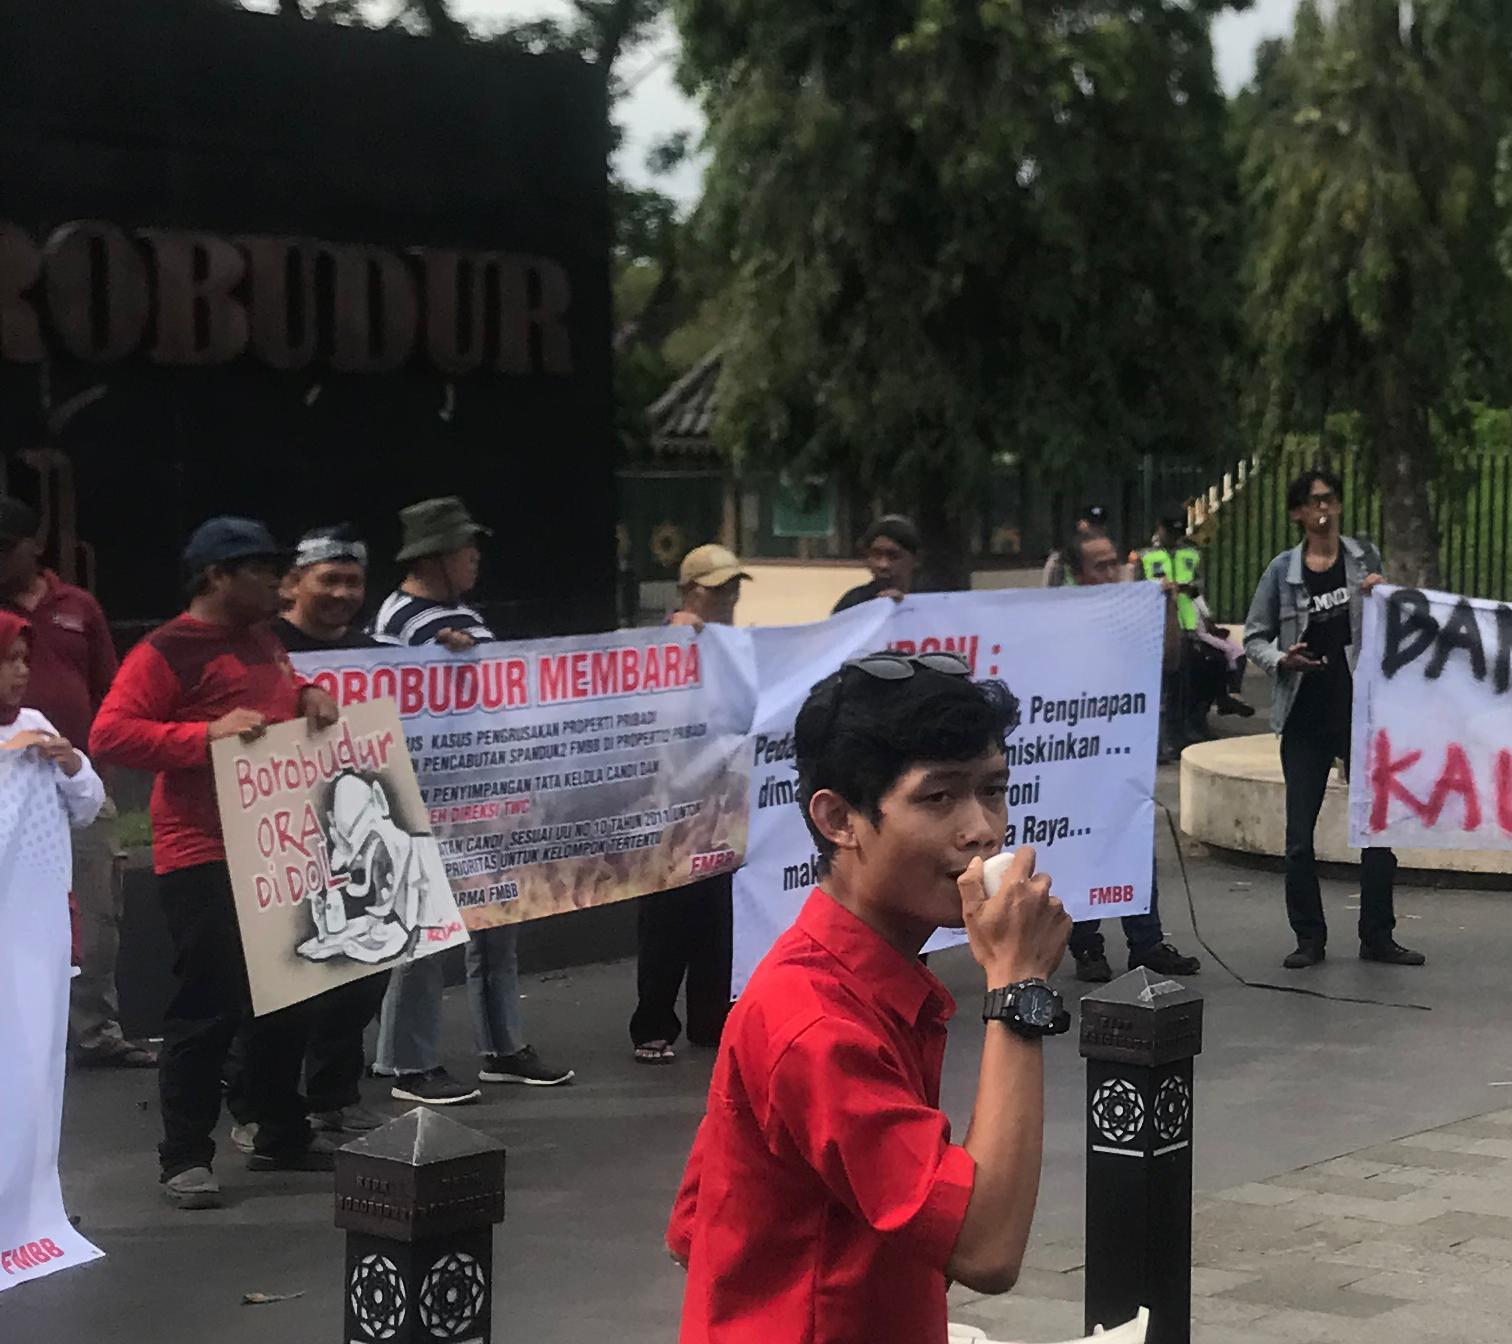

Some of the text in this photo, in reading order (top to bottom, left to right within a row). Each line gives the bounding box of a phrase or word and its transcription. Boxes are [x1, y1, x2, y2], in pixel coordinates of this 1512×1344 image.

[539, 644, 701, 704] MEMBARA
[1029, 692, 1146, 727] Penginapan
[432, 732, 473, 750] KASUS
[477, 722, 559, 746] PENGRUSAKAN
[563, 715, 613, 735] PROPERTI
[236, 720, 394, 809] Borobudur
[423, 751, 506, 772] PENCABUTAN
[570, 738, 600, 755] FMBB
[433, 777, 532, 803] PENYIMPANGAN
[535, 772, 561, 792] TATA
[564, 768, 604, 788] KELOLA
[607, 764, 638, 782] CANDI
[451, 803, 500, 822] DIREKSI
[257, 803, 327, 859] ORA
[466, 833, 504, 853] CANDI
[1022, 815, 1091, 847] Raya...
[445, 854, 499, 878] PRIORITAS
[500, 847, 538, 869] UNTUK
[542, 840, 604, 862] KELOMPOK
[489, 882, 519, 902] FMBB
[1088, 885, 1134, 906] FMBB
[1, 1238, 64, 1275] FMBB
